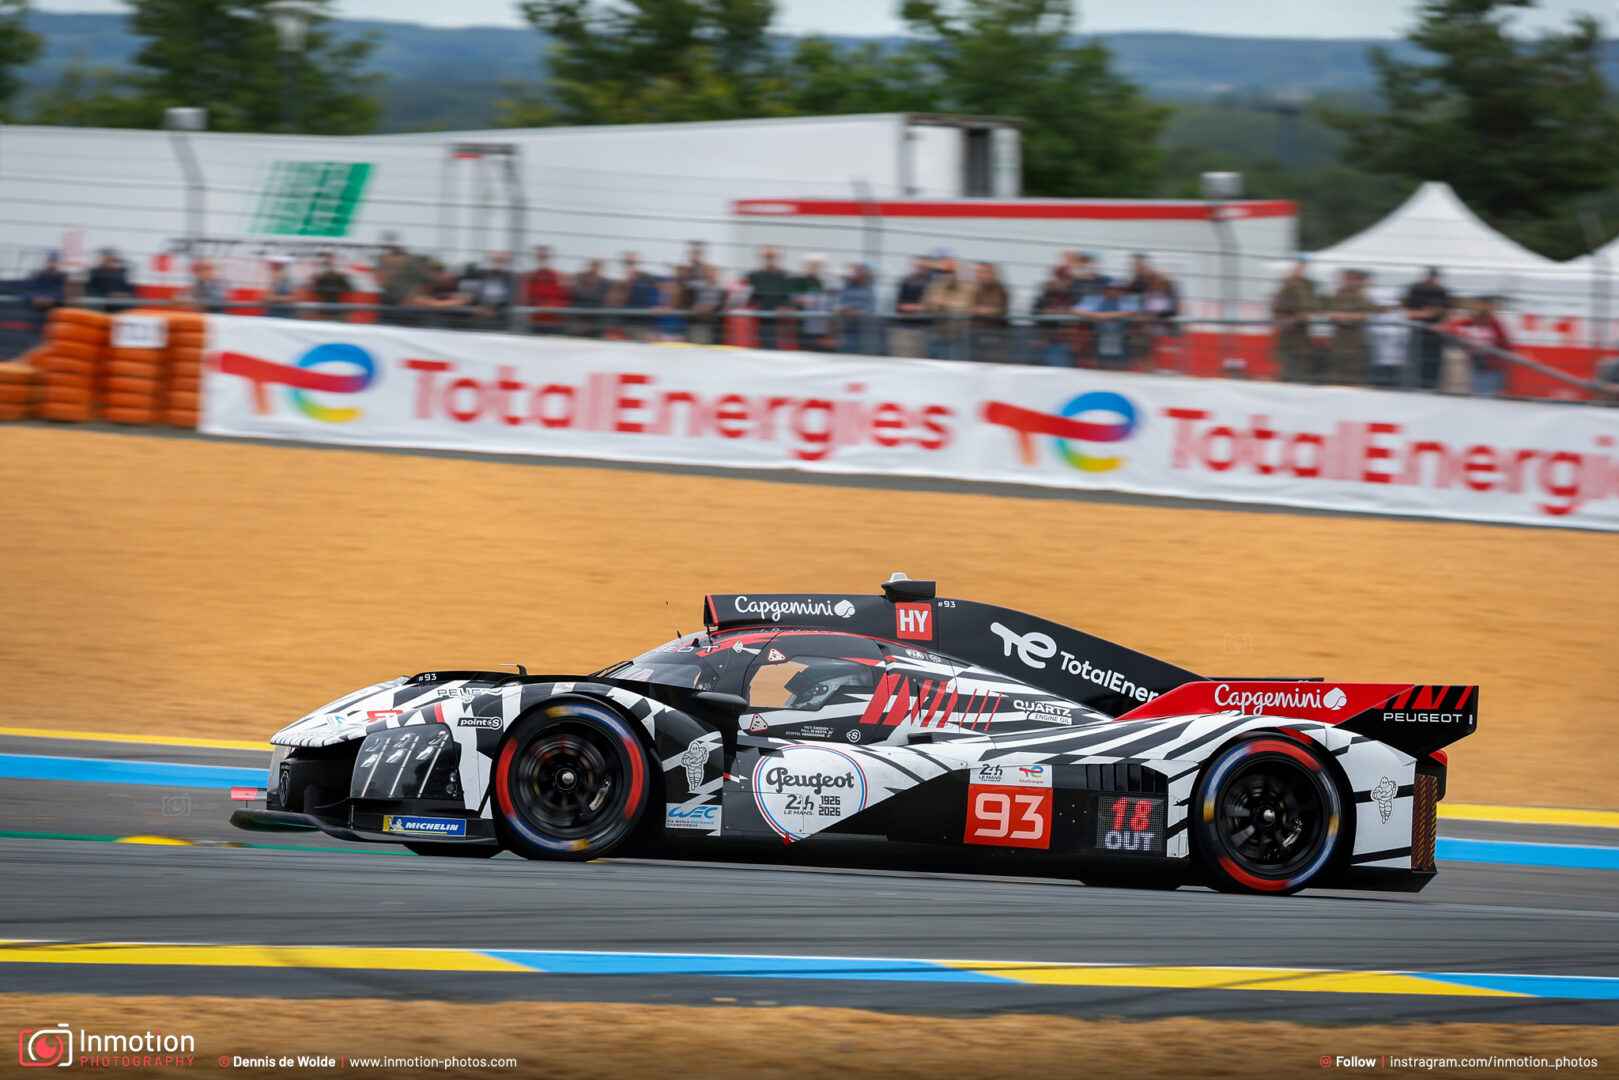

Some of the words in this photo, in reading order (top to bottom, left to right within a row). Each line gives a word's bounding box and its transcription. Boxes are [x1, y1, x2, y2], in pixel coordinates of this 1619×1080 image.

[401, 358, 953, 461] TotalEnergies
[1164, 408, 1619, 516] TotalEnergi
[735, 596, 833, 621] Capgemini
[900, 609, 929, 633] HY
[418, 673, 437, 682] #93
[1013, 699, 1072, 717] QUARTZ
[1214, 684, 1322, 714] Capgemini
[460, 719, 487, 727] point
[1034, 713, 1059, 722] ENGINE
[1383, 712, 1463, 723] PEUGEOT
[766, 767, 855, 795] Peugeot
[820, 795, 841, 806] 1926
[668, 806, 719, 819] WEC
[818, 806, 841, 816] 2026
[973, 793, 1045, 840] 93
[1109, 797, 1153, 831] 18
[405, 822, 459, 831] MICHELIN
[1104, 831, 1154, 851] OUT
